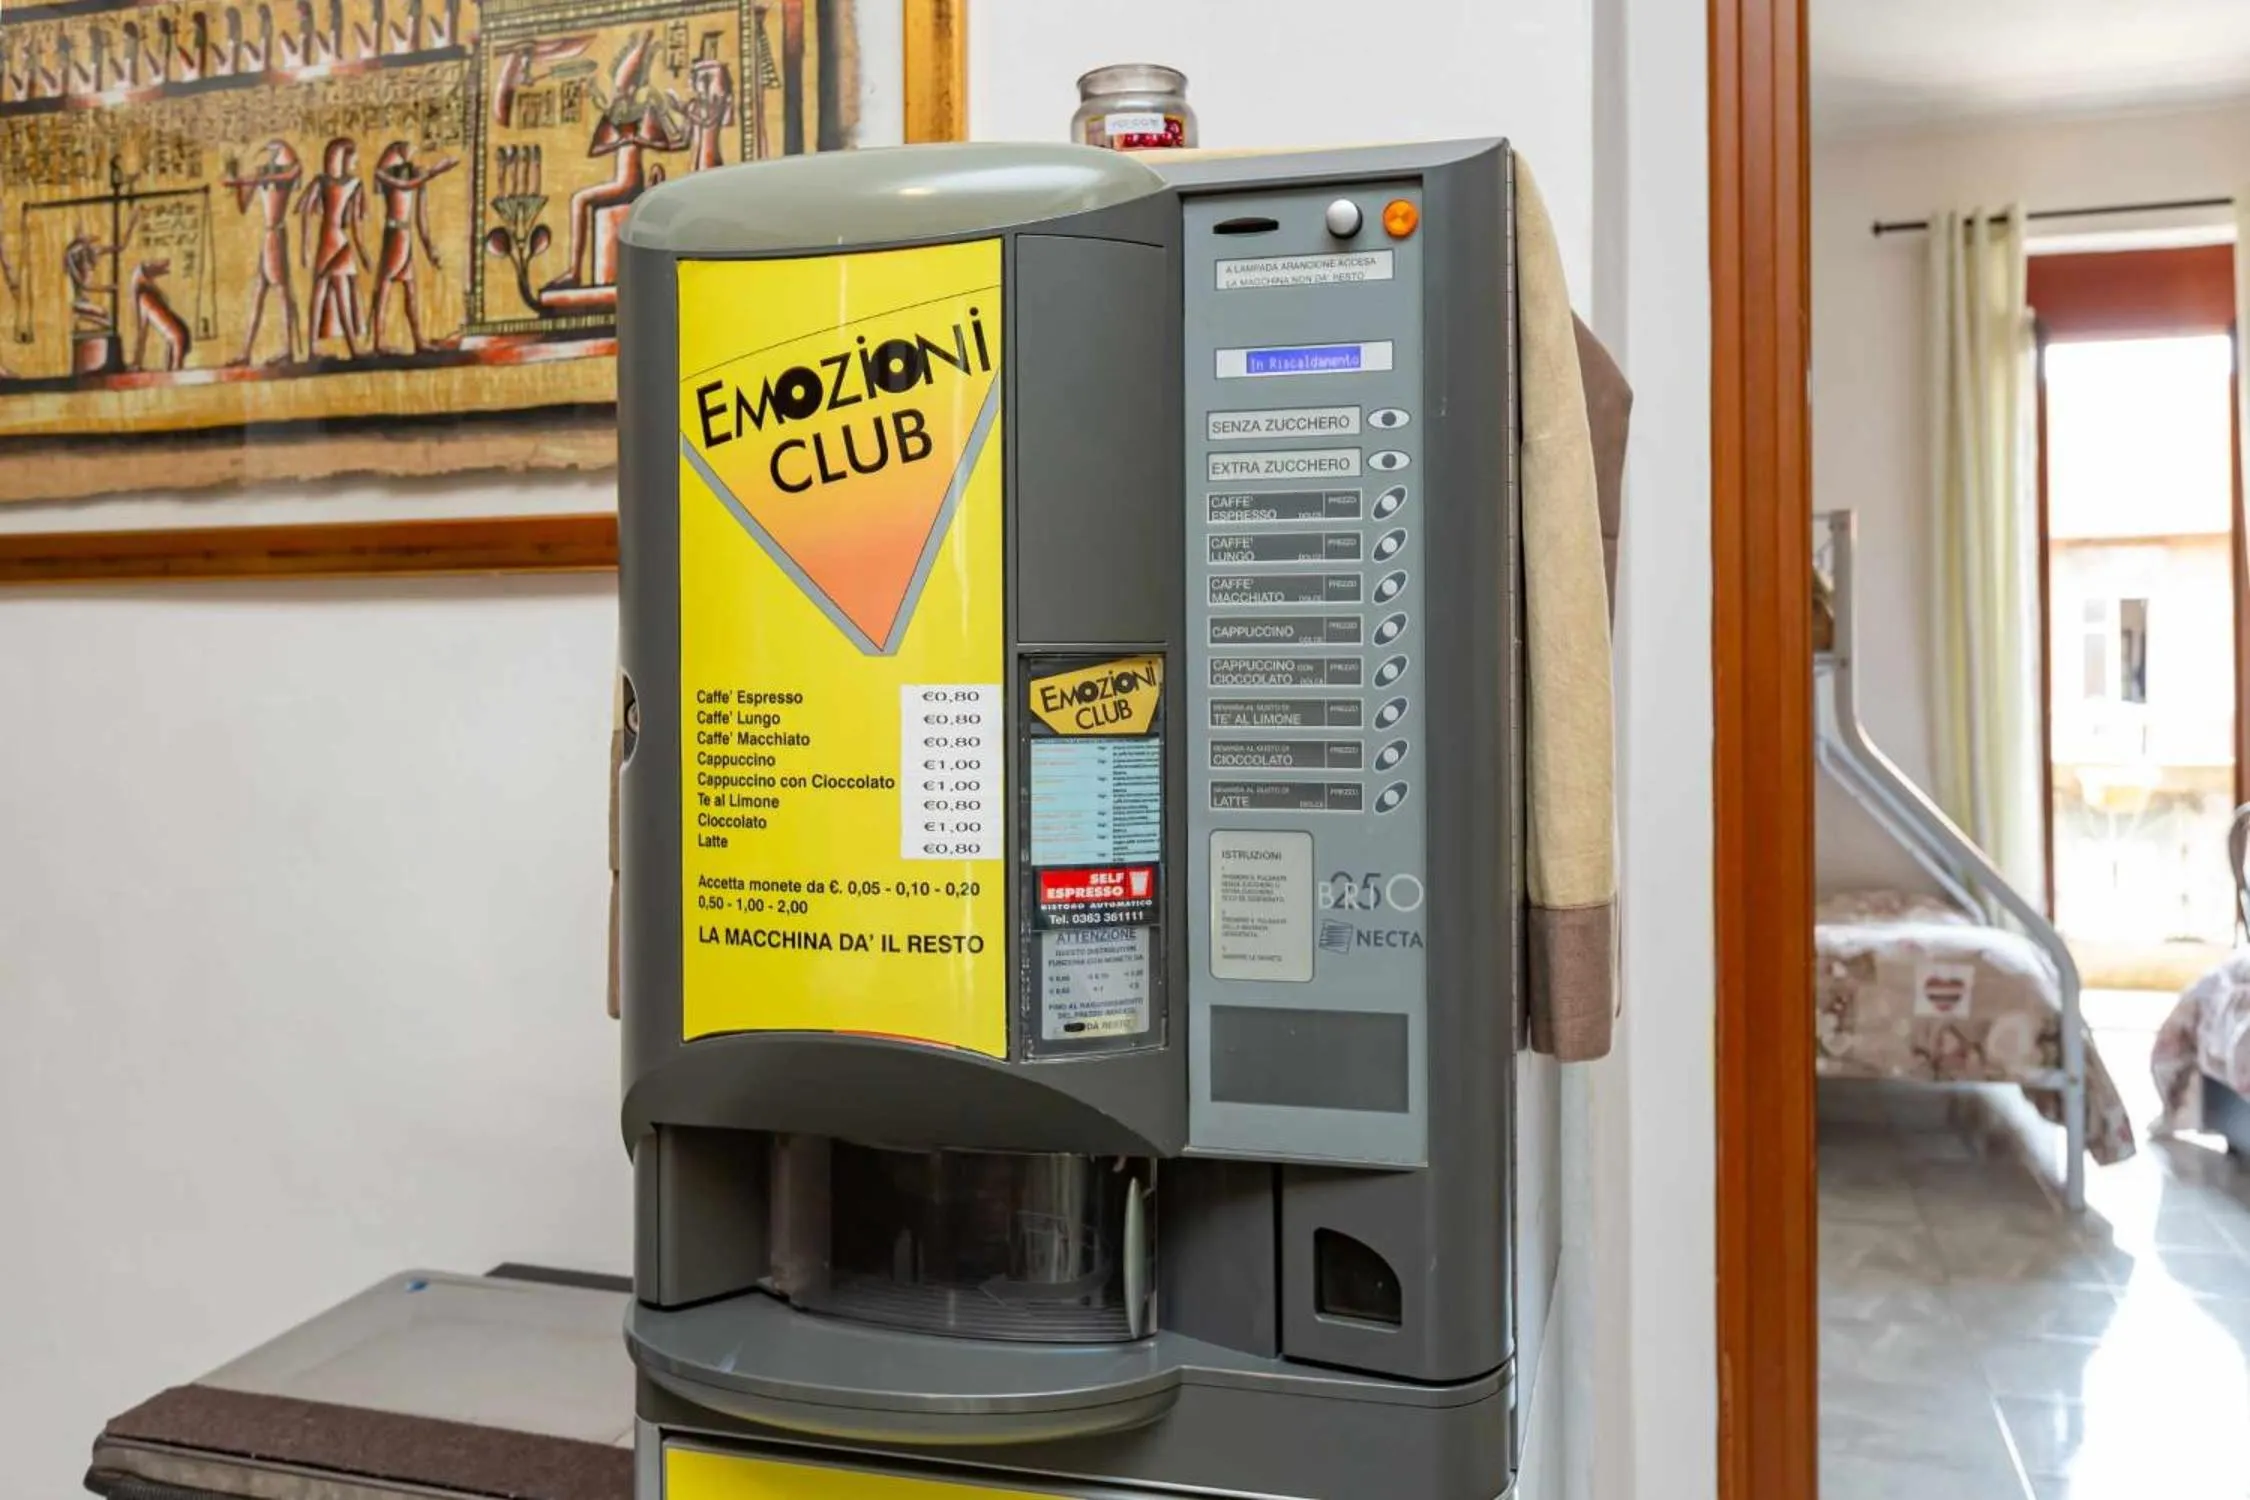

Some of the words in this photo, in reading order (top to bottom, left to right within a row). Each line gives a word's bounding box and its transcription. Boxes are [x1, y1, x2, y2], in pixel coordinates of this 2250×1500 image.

[1234, 263, 1278, 273] LAMPADA
[1280, 260, 1336, 271] ARANCIONE
[1338, 257, 1376, 268] ACCESA
[1269, 353, 1360, 370] Riscaldamento
[1212, 420, 1261, 434] SENZA
[1265, 415, 1350, 432] ZUCCHERO
[769, 408, 933, 494] CLUB
[1211, 461, 1263, 475] EXTRA
[1264, 457, 1350, 473] ZUCCHERO
[1211, 508, 1277, 521] ESPRESSO
[1211, 550, 1255, 561] LUNGO
[1211, 591, 1285, 603] MACCHIATO
[1212, 625, 1294, 637] CAPPUCCINO
[1212, 659, 1295, 672] CAPPUCCINO
[1212, 673, 1293, 685] CIOCCOLATO
[696, 689, 733, 705] Caffe'
[737, 690, 803, 707] Espresso
[696, 710, 733, 725] Caffe'
[737, 711, 780, 729] Lungo
[1075, 699, 1133, 730] CLUB
[1235, 713, 1252, 724] AL
[1253, 713, 1301, 724] LIMONE
[696, 731, 733, 746] Caffe'
[737, 732, 810, 747] Macchiato
[697, 751, 776, 770] Cappuccino
[1212, 754, 1293, 766] CIOCCOLATO
[697, 772, 776, 790] Cappuccino
[780, 775, 806, 788] con
[811, 774, 895, 789] Cioccolato
[697, 793, 711, 807] Te
[714, 793, 725, 807] al
[729, 794, 780, 808] Limone
[1213, 795, 1249, 807] LATTE
[697, 813, 767, 829] Cioccolato
[697, 833, 728, 849] Latte
[1222, 850, 1282, 861] ISTRUZIONI
[1090, 872, 1124, 885] SELF
[698, 875, 745, 891] Accetta
[749, 879, 802, 893] monete
[806, 879, 825, 894] da
[847, 880, 881, 897] 0,05
[895, 881, 930, 898] 0,10
[945, 882, 980, 899] 0,20
[1047, 885, 1124, 899] ESPRESSO
[698, 897, 724, 912] 0,50
[737, 899, 765, 914] 1,00
[777, 899, 808, 914] 2,00
[1049, 914, 1069, 925] Tel.
[1072, 912, 1101, 924] 0363
[699, 926, 720, 944] LA
[725, 927, 833, 950] MACCHINA
[881, 933, 901, 952] IL
[907, 934, 984, 954] RESTO
[1056, 928, 1137, 946] ATTENZIONE
[1356, 929, 1424, 948] NECTA
